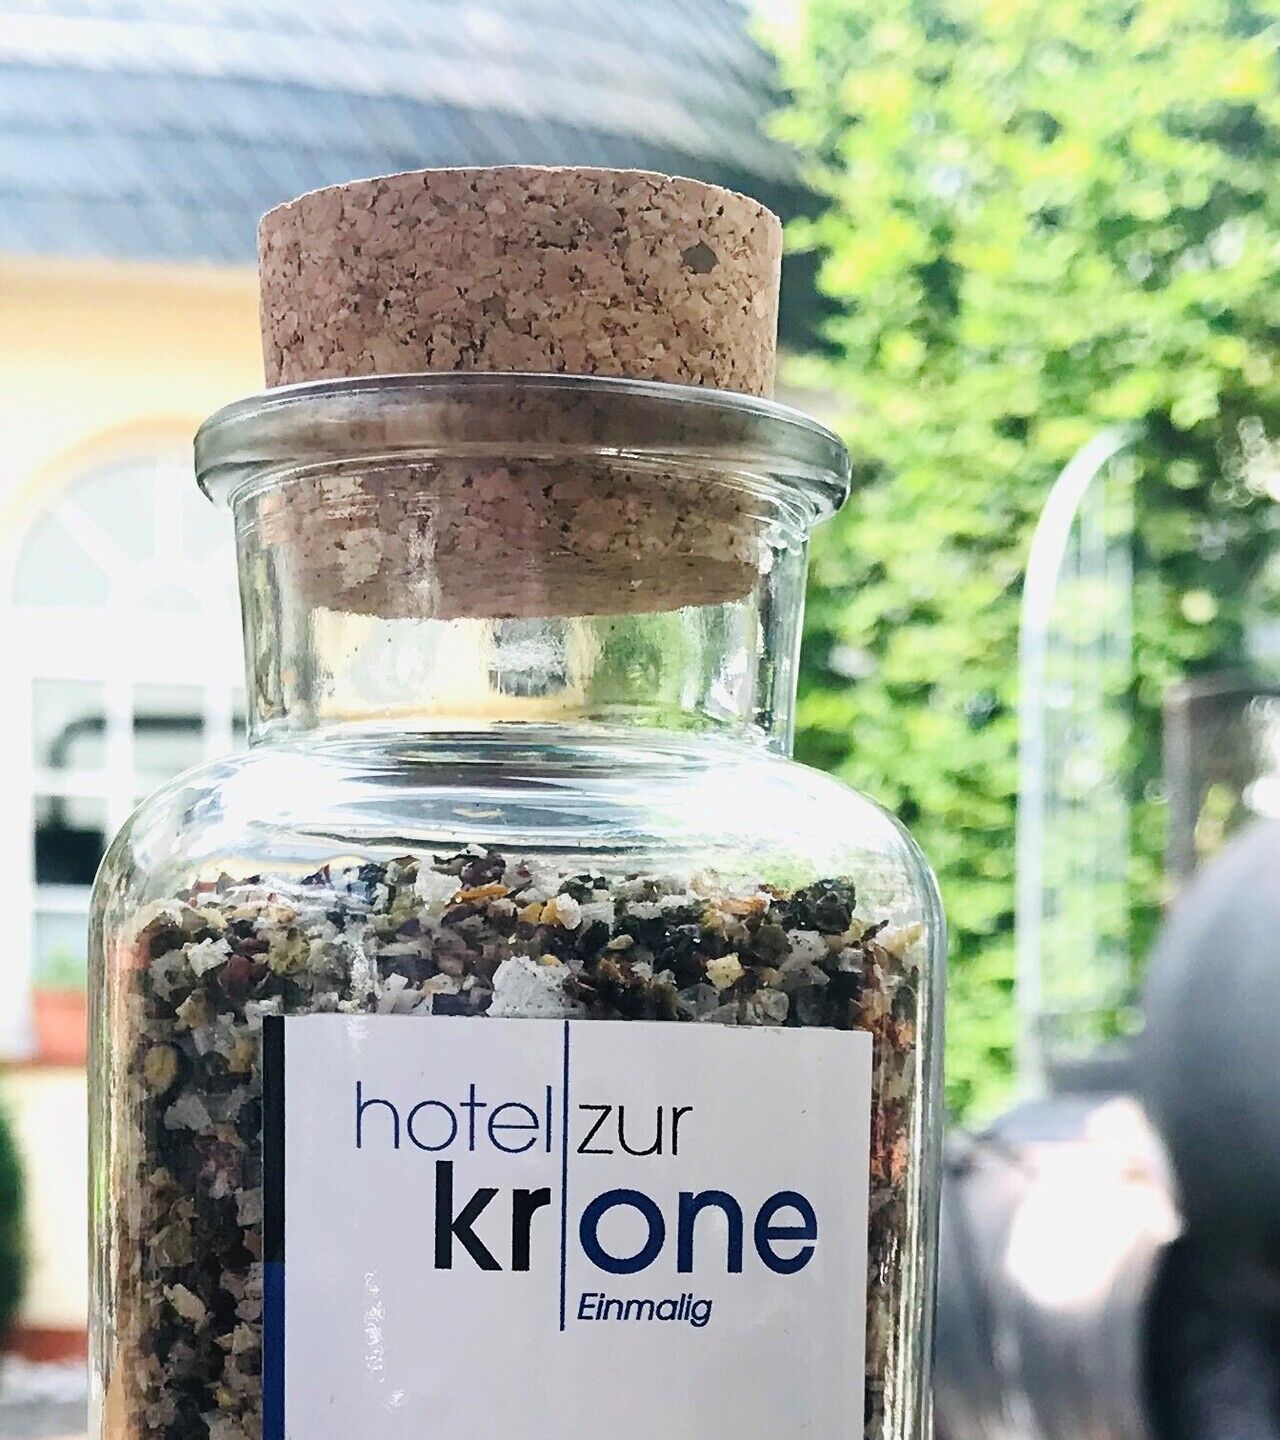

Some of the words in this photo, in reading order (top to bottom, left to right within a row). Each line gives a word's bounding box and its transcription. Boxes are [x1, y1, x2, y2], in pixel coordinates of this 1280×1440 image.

[356, 1081, 552, 1154] hotel
[577, 1105, 693, 1156] zur
[577, 1293, 713, 1327] Einmalig
